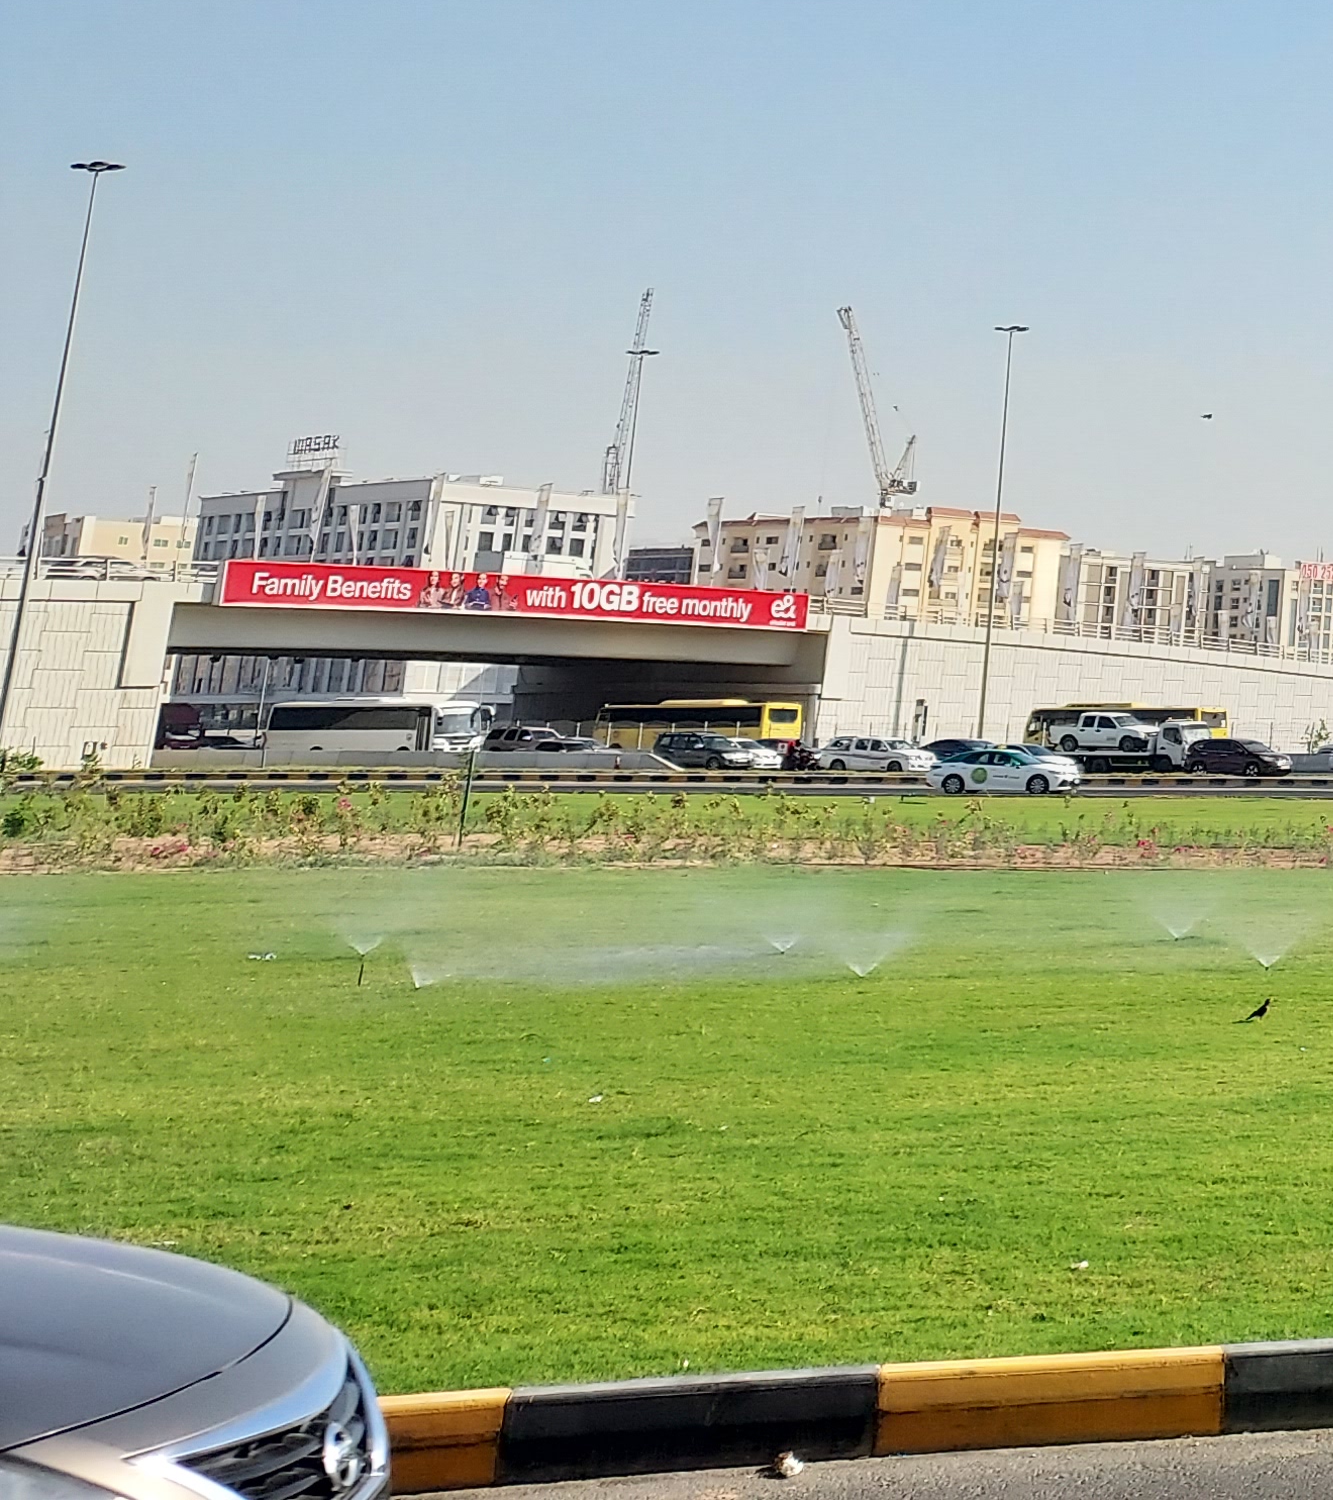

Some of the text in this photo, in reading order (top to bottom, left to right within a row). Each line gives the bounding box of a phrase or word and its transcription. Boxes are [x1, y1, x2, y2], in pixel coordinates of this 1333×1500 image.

[251, 571, 412, 601] Family Benefits
[526, 582, 752, 623] with 10GB free monthly
